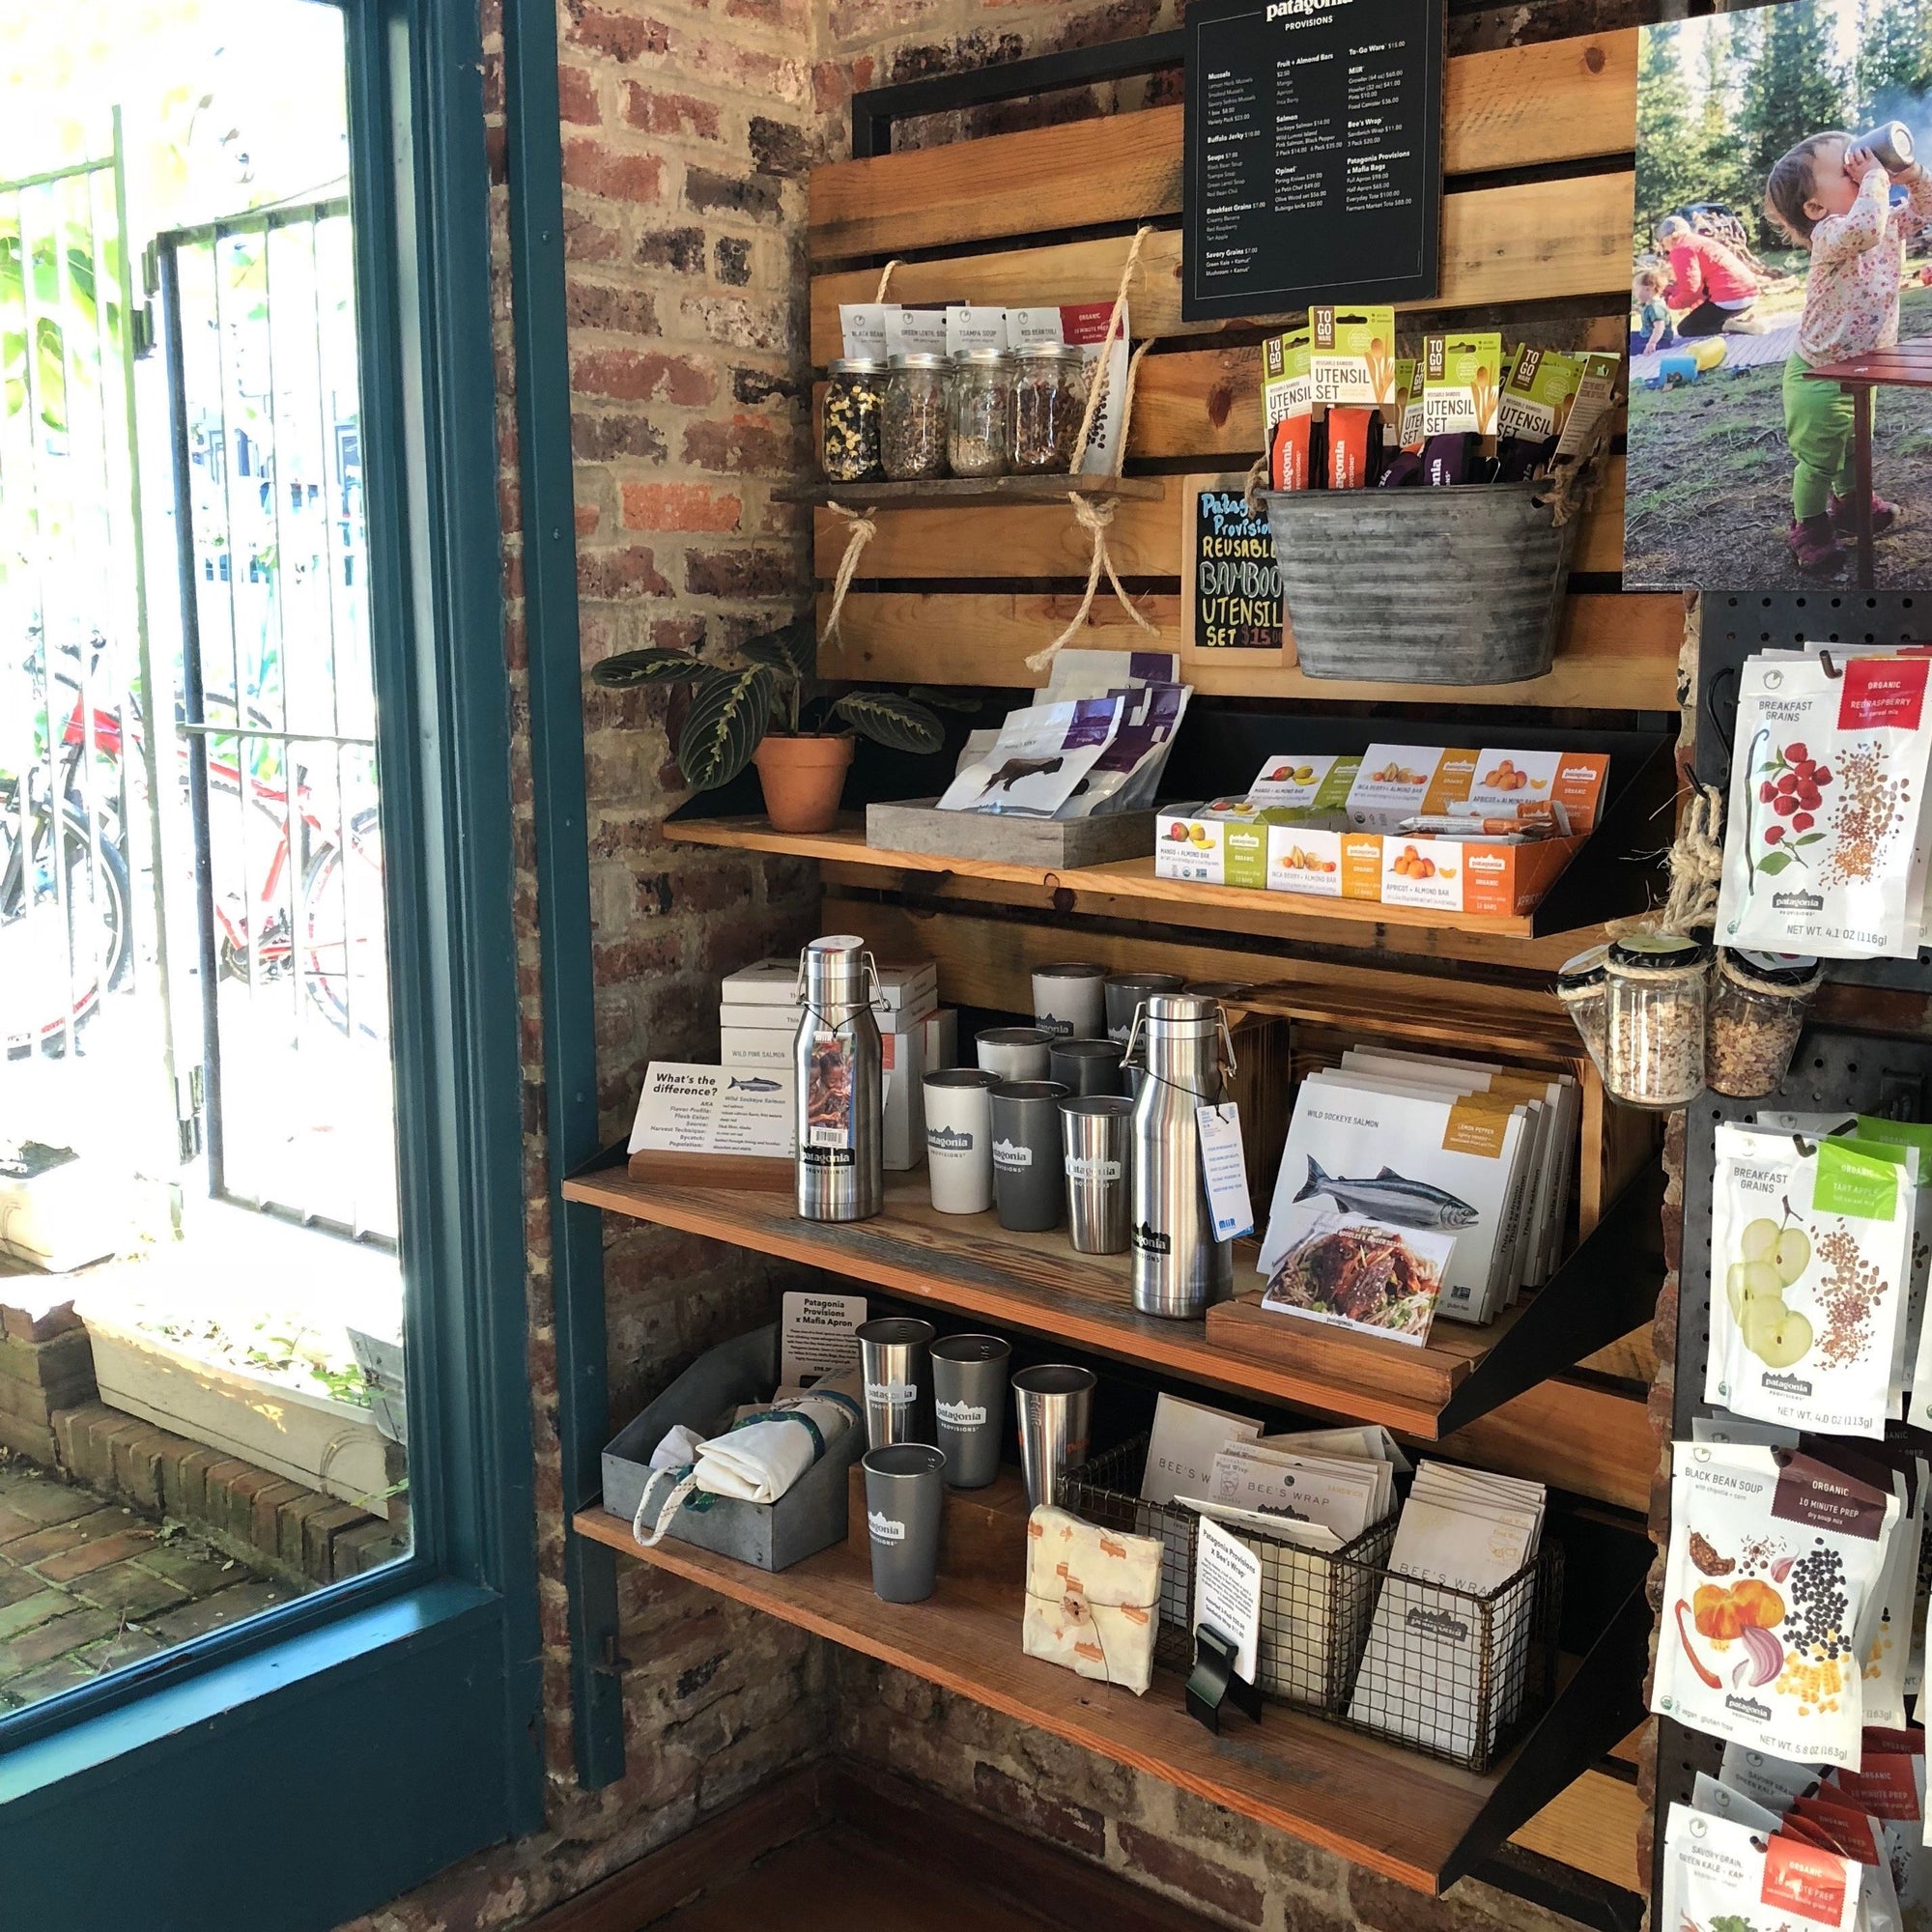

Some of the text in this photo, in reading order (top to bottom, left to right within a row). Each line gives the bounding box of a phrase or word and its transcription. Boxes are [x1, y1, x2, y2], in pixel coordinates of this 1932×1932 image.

[1285, 15, 1333, 31] PROVISIONS
[1350, 46, 1368, 55] To-Go
[1296, 55, 1320, 66] Almond
[1208, 71, 1231, 80] Mussels
[1276, 114, 1297, 123] Salmon
[1208, 131, 1243, 144] Buffalo Jerky
[1348, 151, 1410, 165] Patagonia Provisions
[1275, 167, 1295, 176] Opinel
[1207, 205, 1233, 214] Breakfast
[1207, 250, 1225, 259] Savory
[1079, 312, 1101, 321] ORGANIC
[1318, 311, 1331, 323] TO
[1318, 324, 1331, 334] GO
[1268, 339, 1281, 352] TO
[1430, 340, 1442, 352] TO
[1269, 352, 1281, 364] GO
[1430, 353, 1442, 366] GO
[1526, 349, 1540, 364] TO
[1316, 369, 1370, 384] UTENSIL
[1520, 363, 1535, 377] GO
[1269, 386, 1312, 410] UTENSIL
[1316, 385, 1339, 400] SET
[1427, 400, 1474, 415] UTENSIL
[1270, 408, 1290, 425] SET
[1500, 406, 1551, 436] UTENSIL
[1427, 417, 1447, 433] SET
[1497, 423, 1520, 439] SET
[1403, 430, 1418, 446] SET
[1283, 440, 1293, 491] tagonia
[1335, 440, 1346, 489] agonia
[1201, 493, 1248, 518] Patag
[1213, 515, 1271, 537] Provisio
[1200, 560, 1283, 598] BAMBOO
[1203, 597, 1283, 627] UTENSIL
[1207, 626, 1236, 646] SET
[1868, 681, 1901, 690] ORGANIC
[1759, 700, 1813, 711] BREAKFAST
[1851, 698, 1911, 709] RED RASPBERRY
[1766, 711, 1800, 722] GRAINS
[1386, 883, 1408, 892] APRICOT
[1414, 886, 1436, 895] ALMOND
[1776, 898, 1819, 907] patagonia
[1787, 924, 1887, 947] NET WT. 4.1 OZ (116g)
[656, 1073, 716, 1086] What's the
[653, 1084, 718, 1096] difference?
[1307, 1110, 1379, 1128] WILD SOCKEYE SALMON
[1458, 1123, 1474, 1132] LEMON
[1734, 1167, 1788, 1184] BREAKFAST
[1740, 1179, 1775, 1194] GRAINS
[1833, 1183, 1879, 1195] TART APPLE
[804, 1298, 844, 1308] Patagonia
[804, 1308, 845, 1317] Provisions
[827, 1319, 852, 1327] Apron
[1765, 1378, 1808, 1393] patagonia
[938, 1407, 981, 1421] patagonia
[1777, 1406, 1872, 1430] NET WT. 4.0 OZ (113g)
[1158, 1458, 1195, 1479] BEE'S
[1685, 1466, 1763, 1494] BLACK BEAN SOUP
[1247, 1481, 1330, 1506] BEE'S WRAP
[1812, 1480, 1850, 1496] ORGANIC
[1799, 1496, 1860, 1519] 10 MINUTE PREP
[1807, 1511, 1816, 1520] dry
[1817, 1514, 1832, 1523] soup
[1203, 1528, 1256, 1574] Patagonia Provisions
[1216, 1550, 1245, 1578] Bee's Wrap
[1400, 1562, 1491, 1596] BEE'S WRA
[1728, 1700, 1767, 1719] patagonia
[1760, 1735, 1847, 1760] NET WT. 5.8 OZ (163g)
[1691, 1846, 1742, 1868] SAVORY GRAIN
[1701, 1861, 1720, 1873] KALE
[1789, 1861, 1823, 1877] ORGANIC
[1814, 1889, 1834, 1902] PREP
